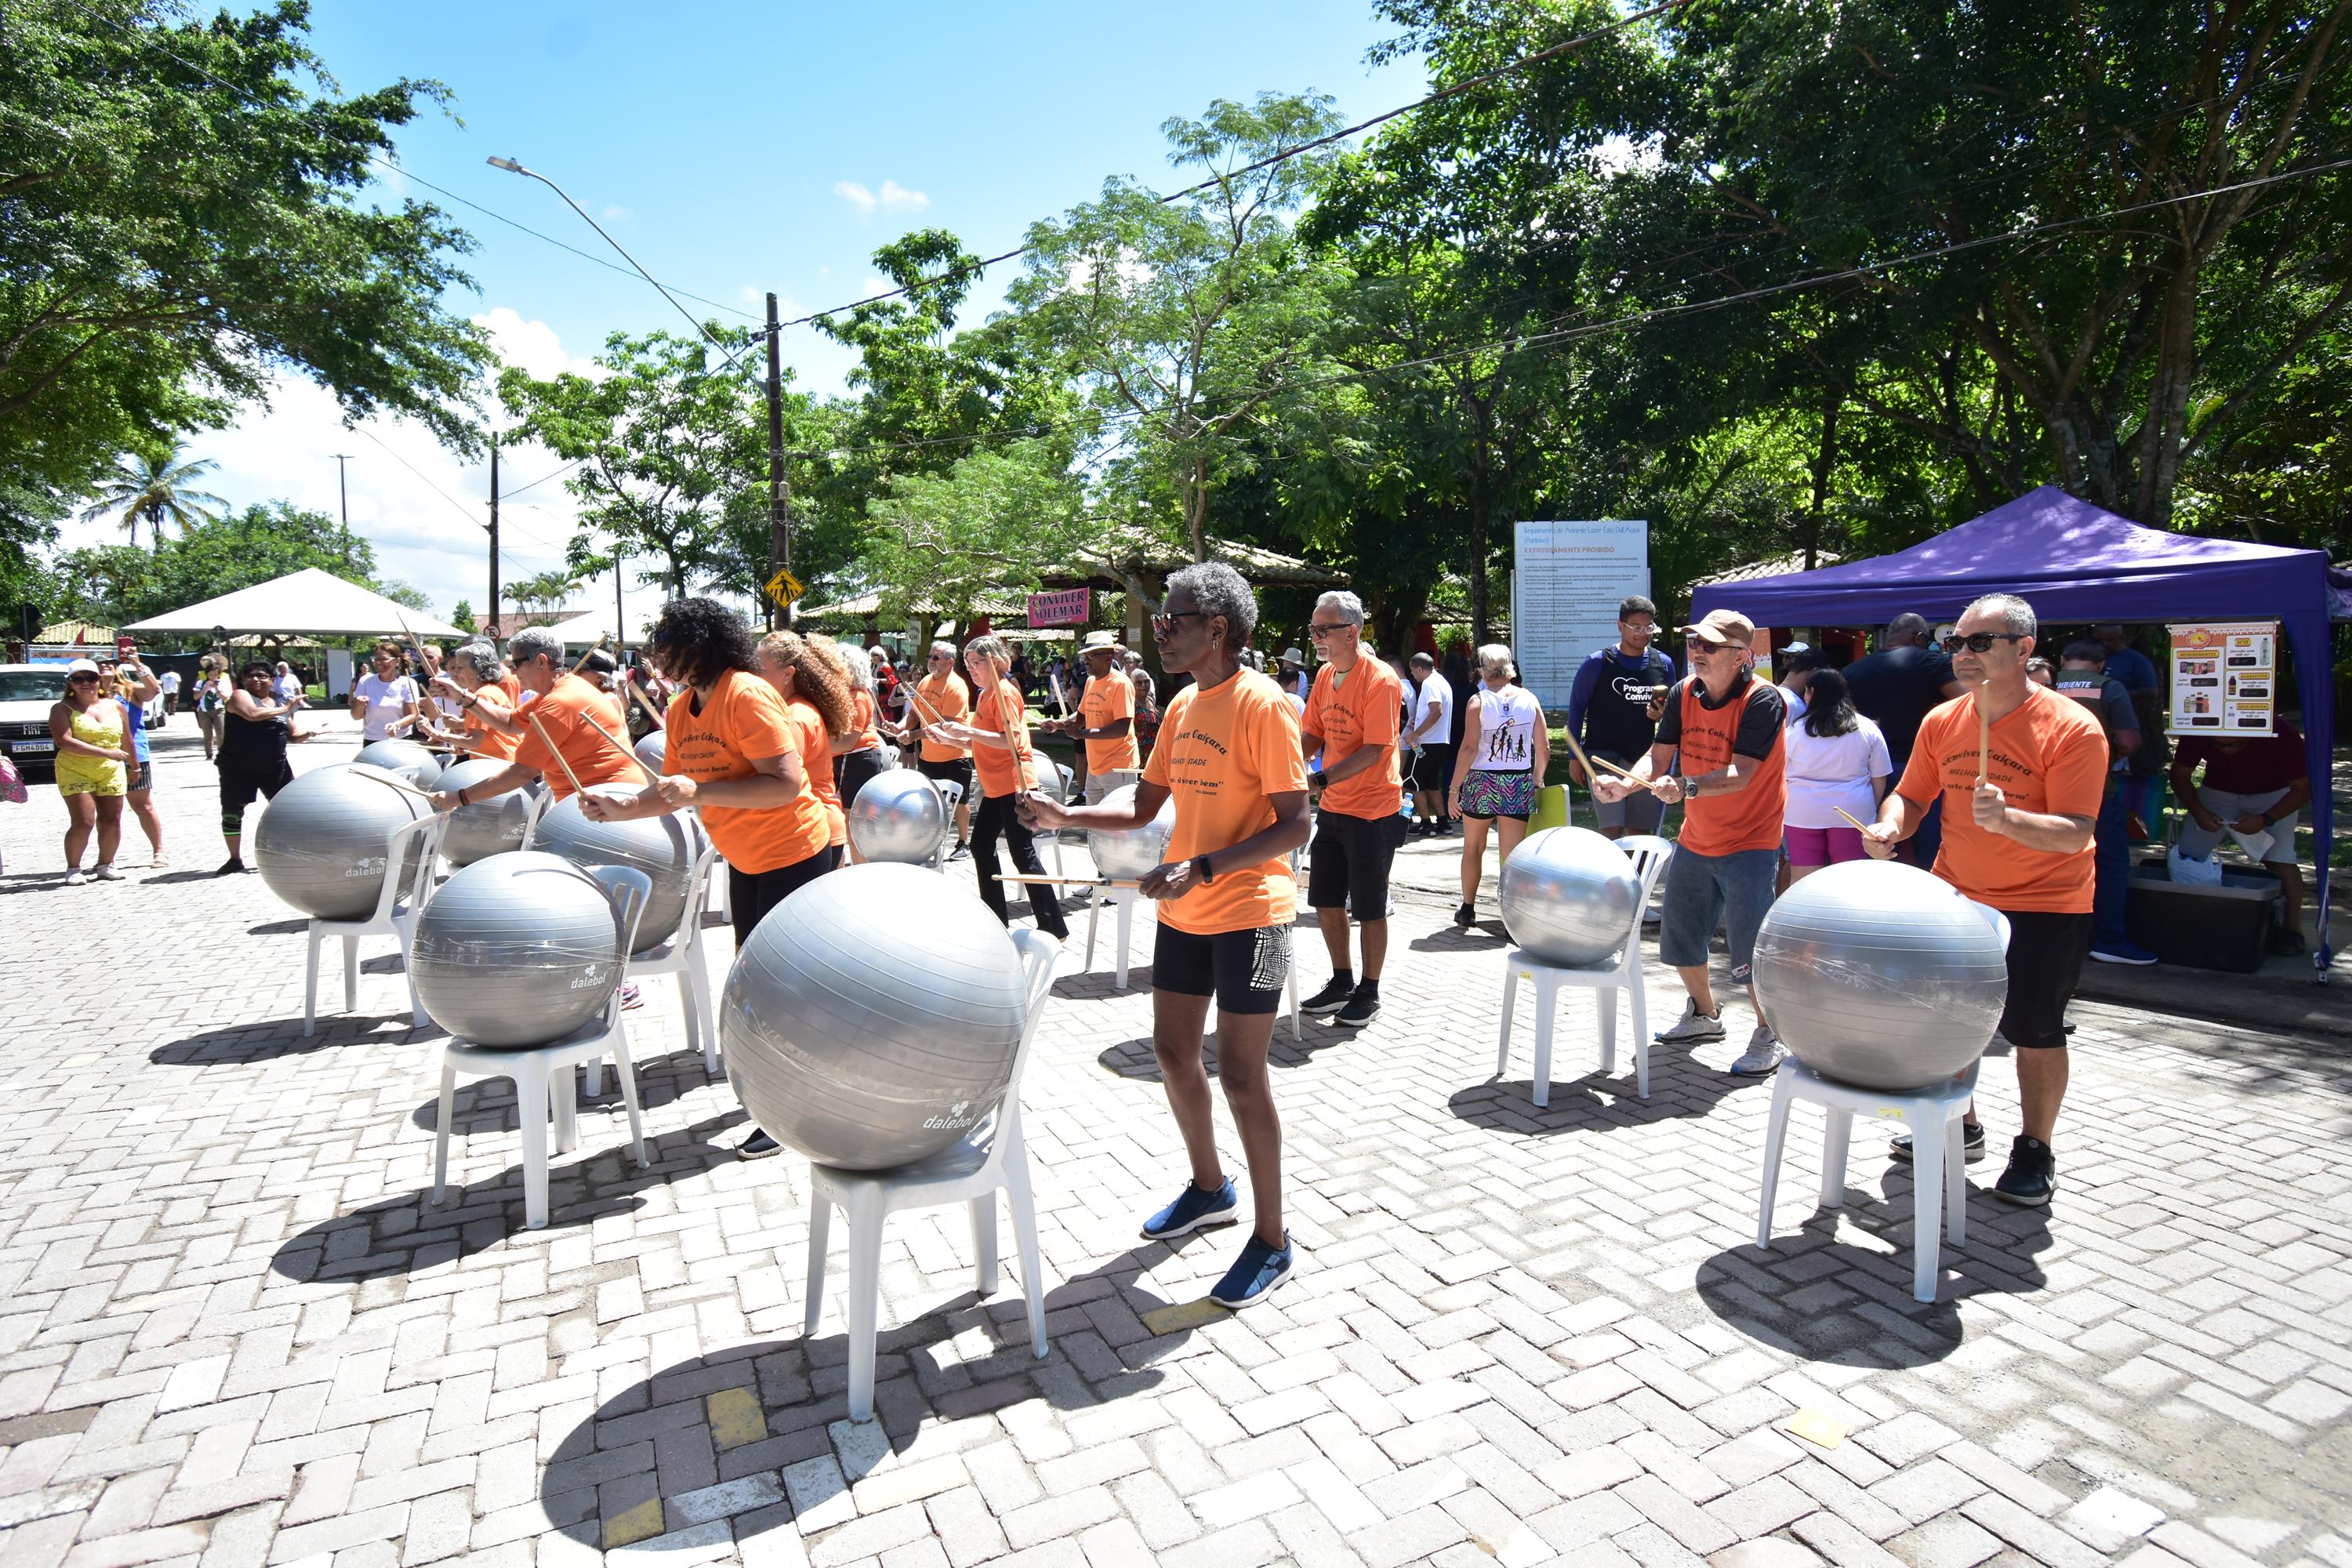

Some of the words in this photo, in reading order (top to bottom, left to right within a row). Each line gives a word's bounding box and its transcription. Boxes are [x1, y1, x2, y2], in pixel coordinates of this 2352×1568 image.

[1033, 590, 1084, 608] CONVIVER
[1035, 604, 1083, 619] SOLEMAR
[1623, 684, 1657, 694] Progra
[2056, 681, 2092, 689] MBIENTE
[23, 724, 41, 735] FIAT
[1192, 729, 1227, 755] Caiçara
[1187, 757, 1207, 766] IDADE
[1987, 750, 2032, 776] Caiçara
[345, 864, 385, 877] dalebol
[571, 972, 607, 989] dalebol
[923, 1113, 978, 1130] dalebol
